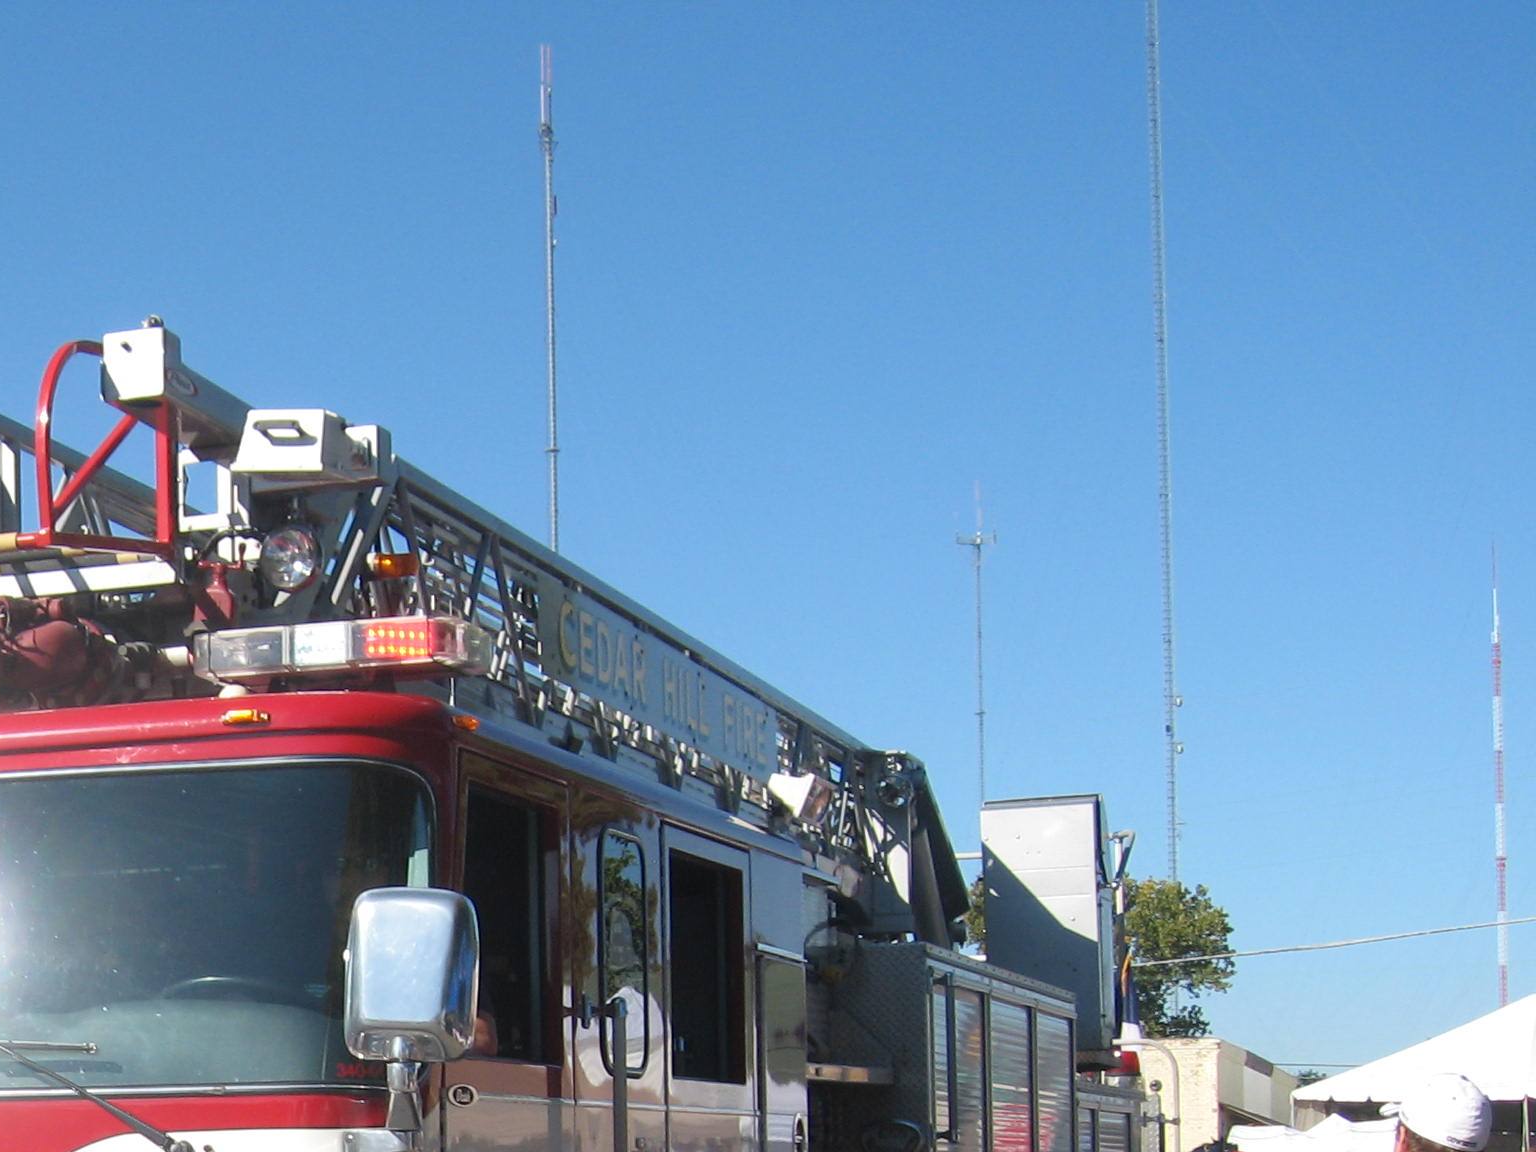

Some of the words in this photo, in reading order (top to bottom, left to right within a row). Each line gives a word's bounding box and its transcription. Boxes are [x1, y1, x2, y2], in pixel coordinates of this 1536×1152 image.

[558, 600, 648, 706] CEDAR
[663, 657, 713, 738] HILL
[723, 691, 770, 767] FIRE
